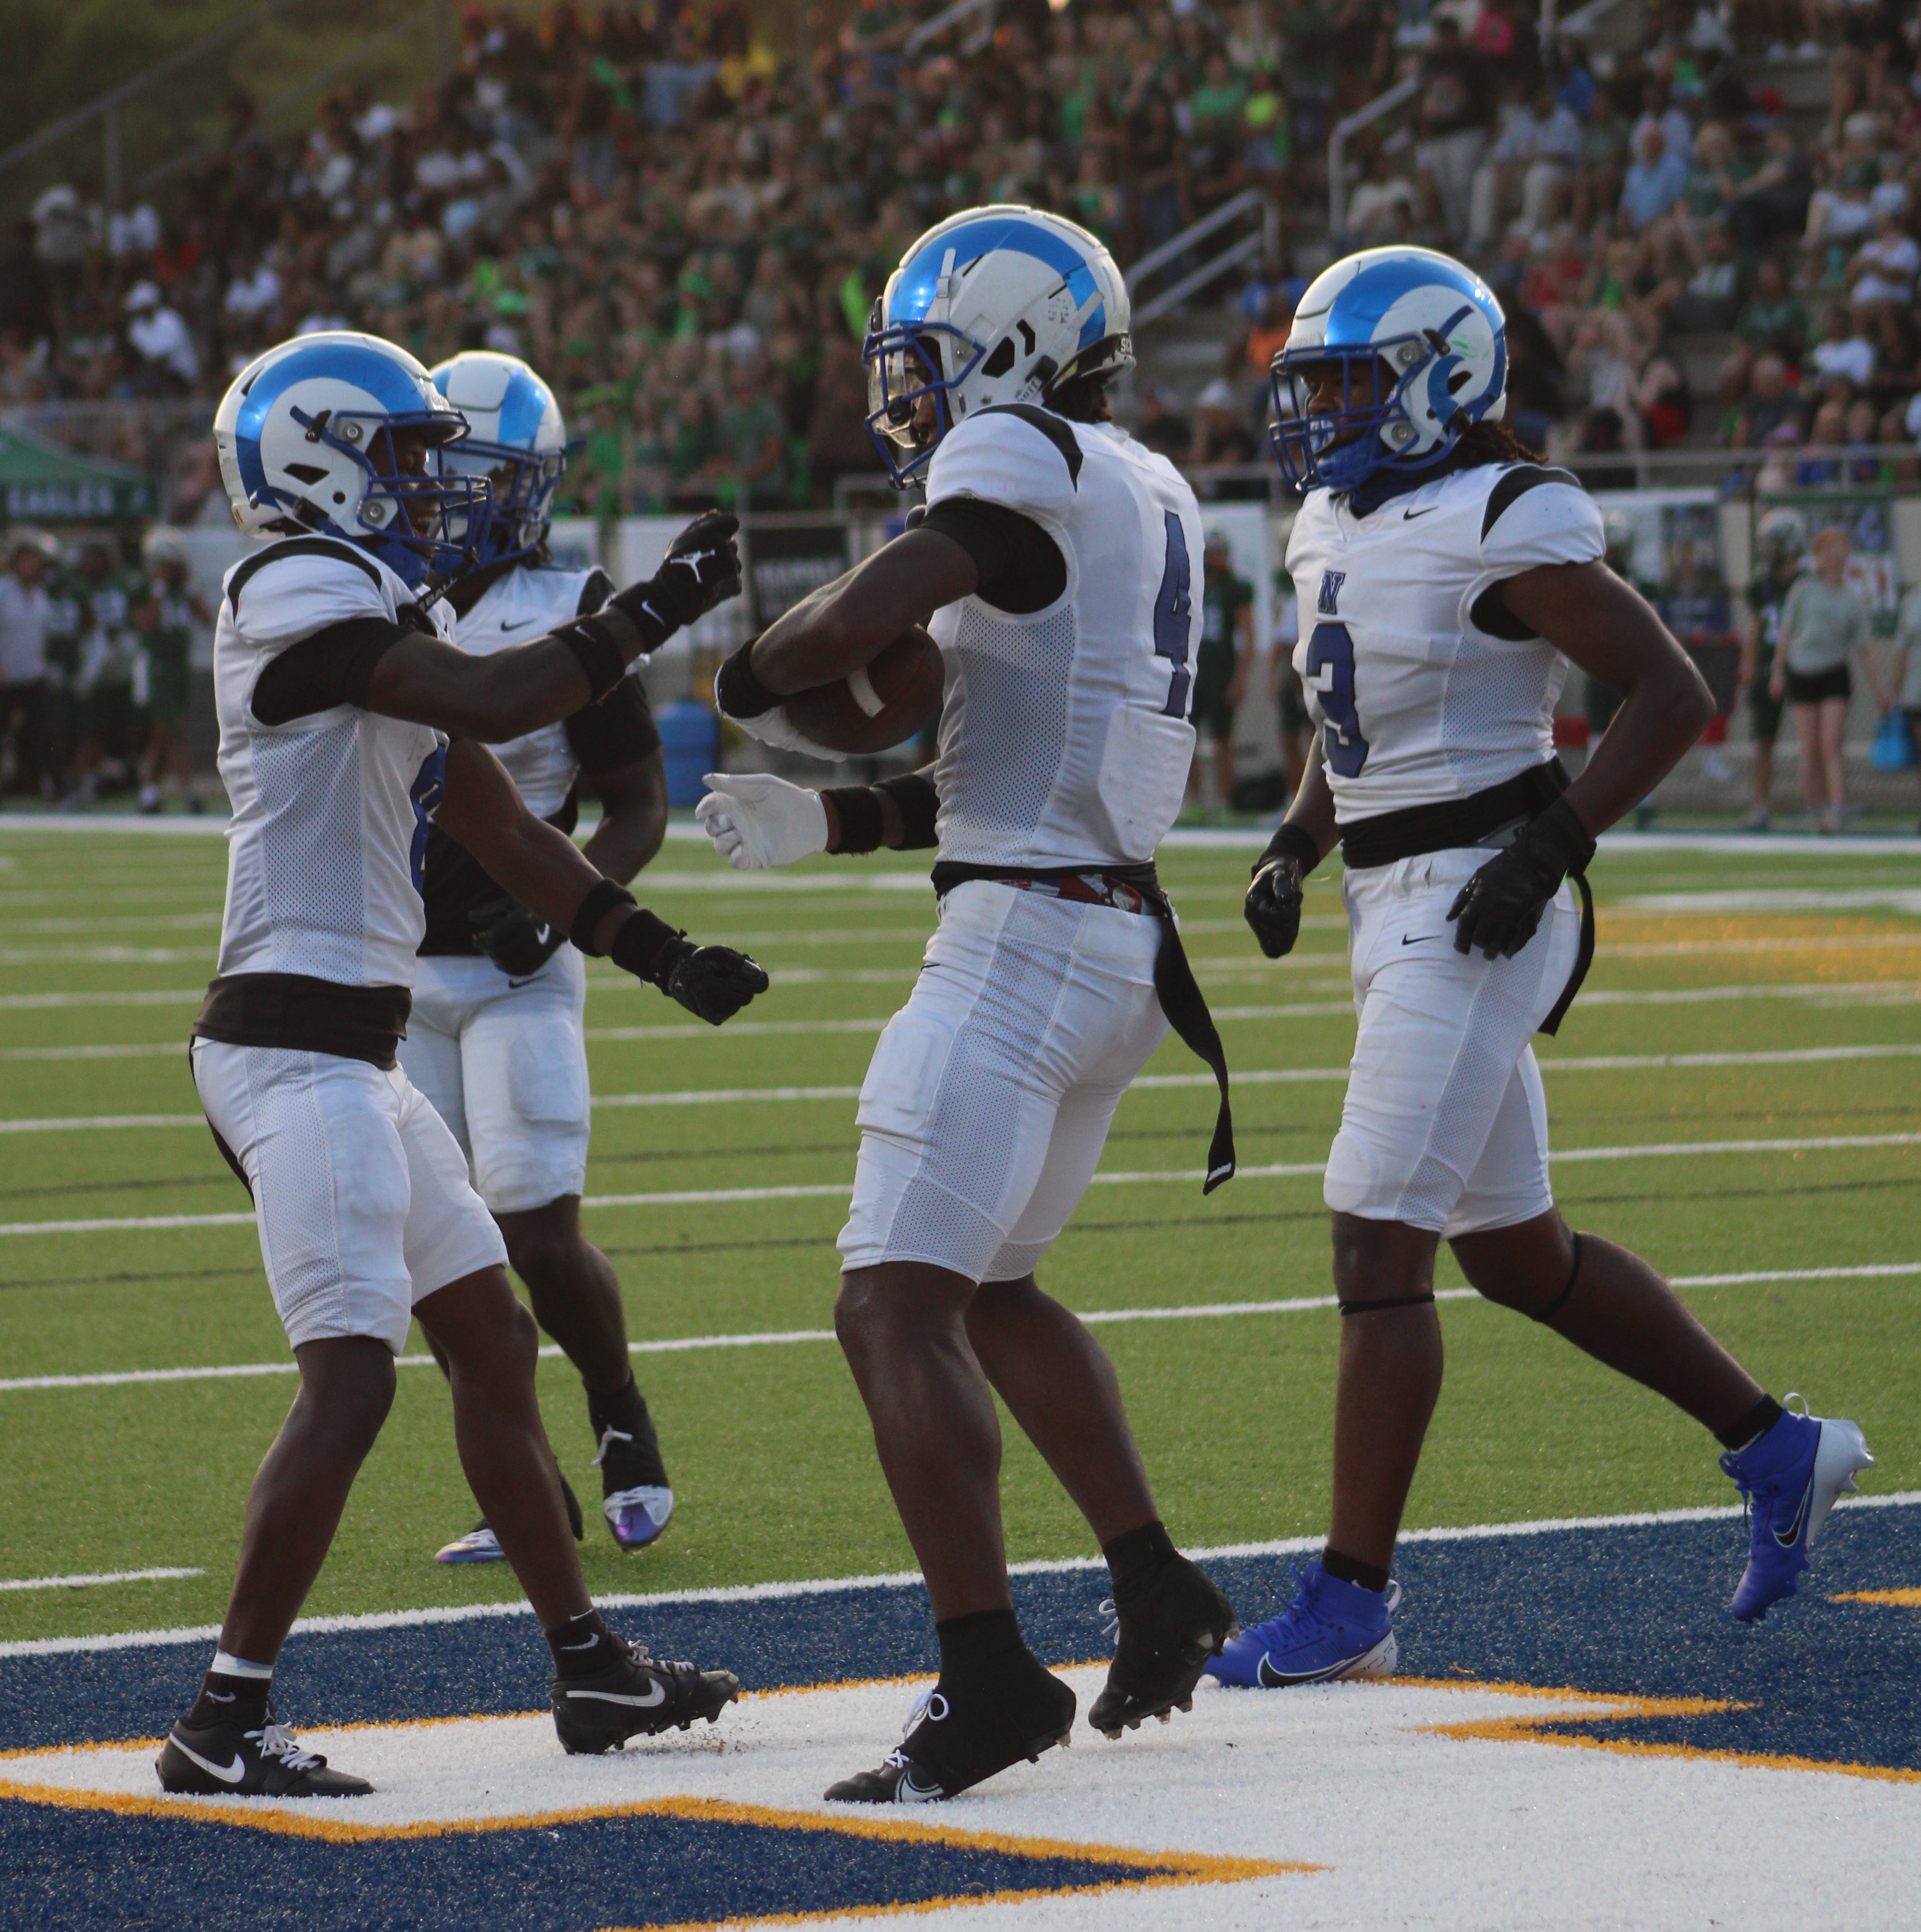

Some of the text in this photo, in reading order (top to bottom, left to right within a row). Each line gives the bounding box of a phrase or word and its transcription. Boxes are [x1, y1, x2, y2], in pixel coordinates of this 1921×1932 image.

[1153, 509, 1191, 718] 4
[1317, 571, 1346, 614] N
[1306, 623, 1369, 778] 3
